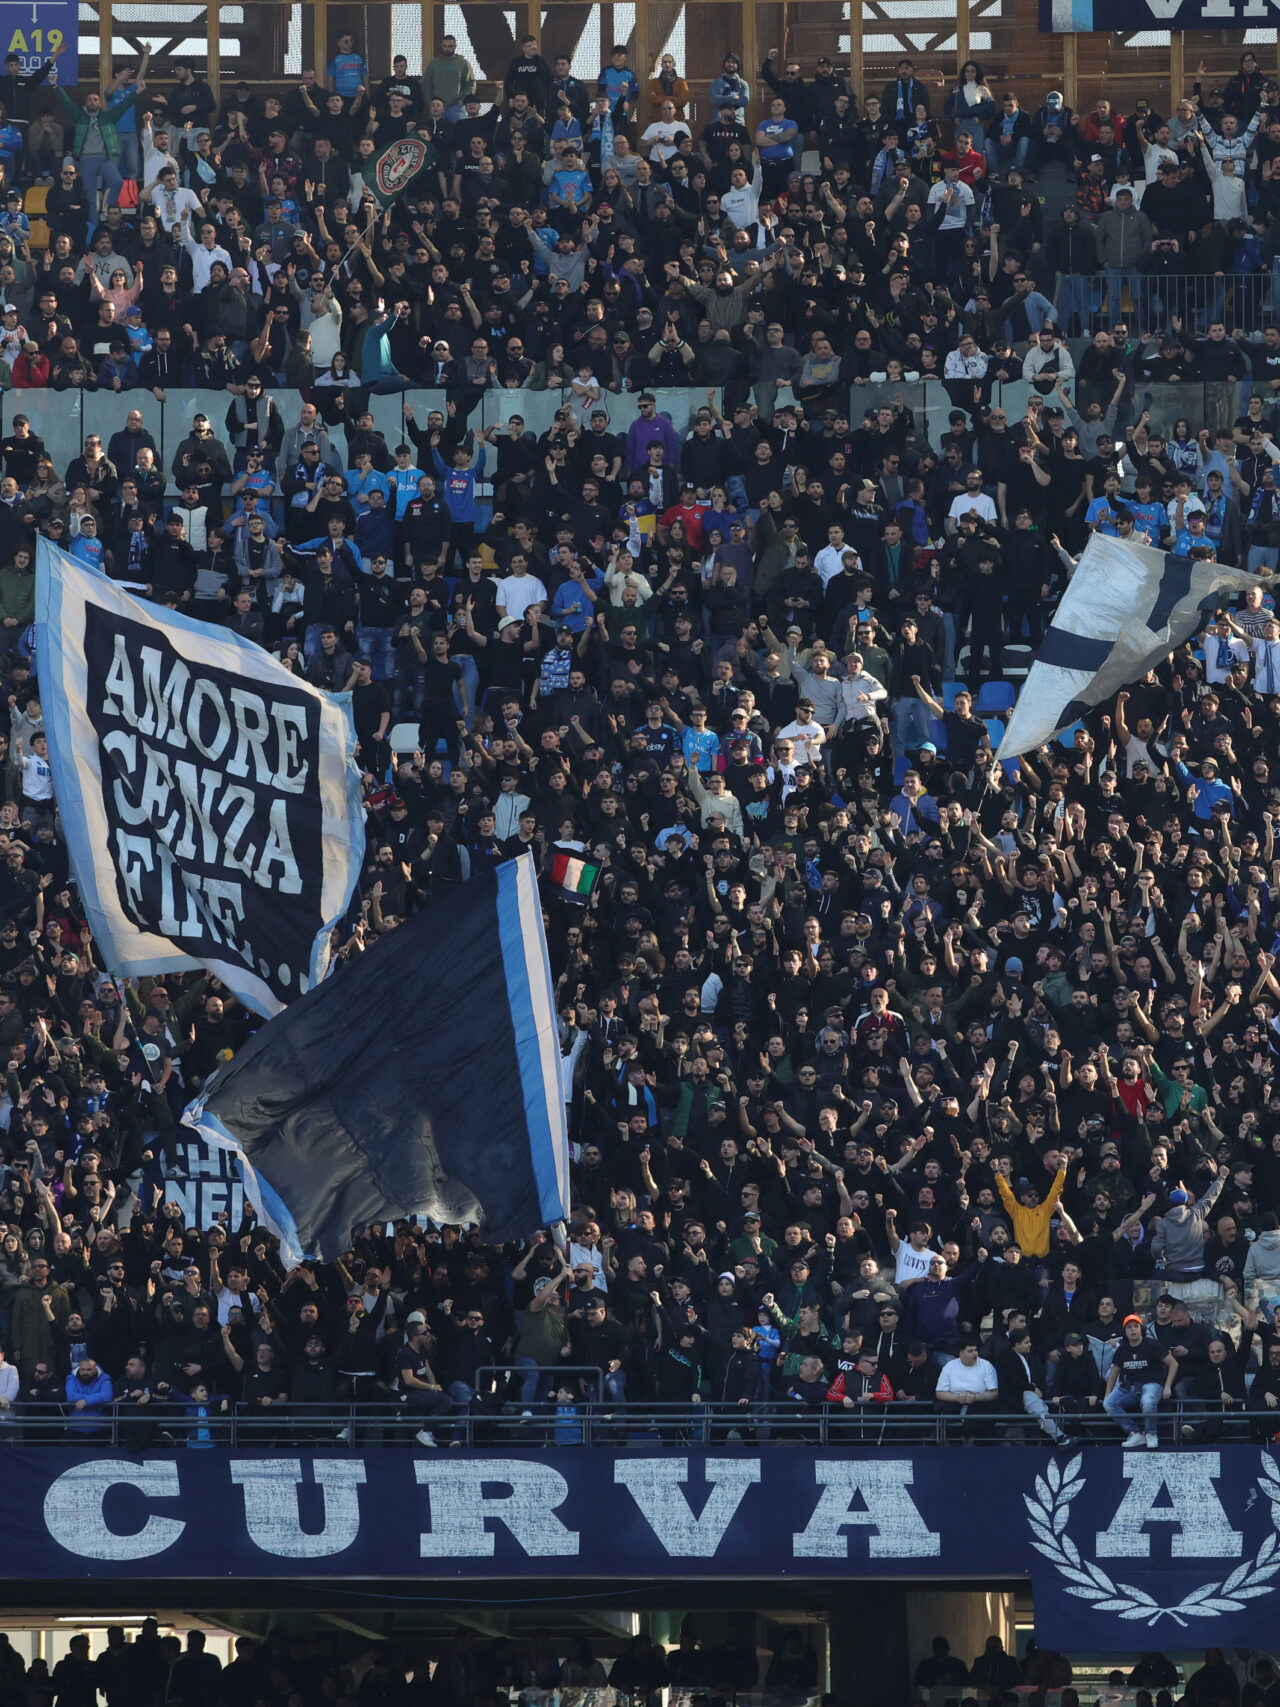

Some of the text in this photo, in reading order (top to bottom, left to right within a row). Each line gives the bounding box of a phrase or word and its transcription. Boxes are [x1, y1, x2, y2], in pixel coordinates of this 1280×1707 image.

[8, 29, 63, 53] A19
[102, 633, 308, 794] AMORE
[646, 742, 666, 752] ebay
[43, 1457, 941, 1561] CURVA
[1095, 1451, 1243, 1558] A
